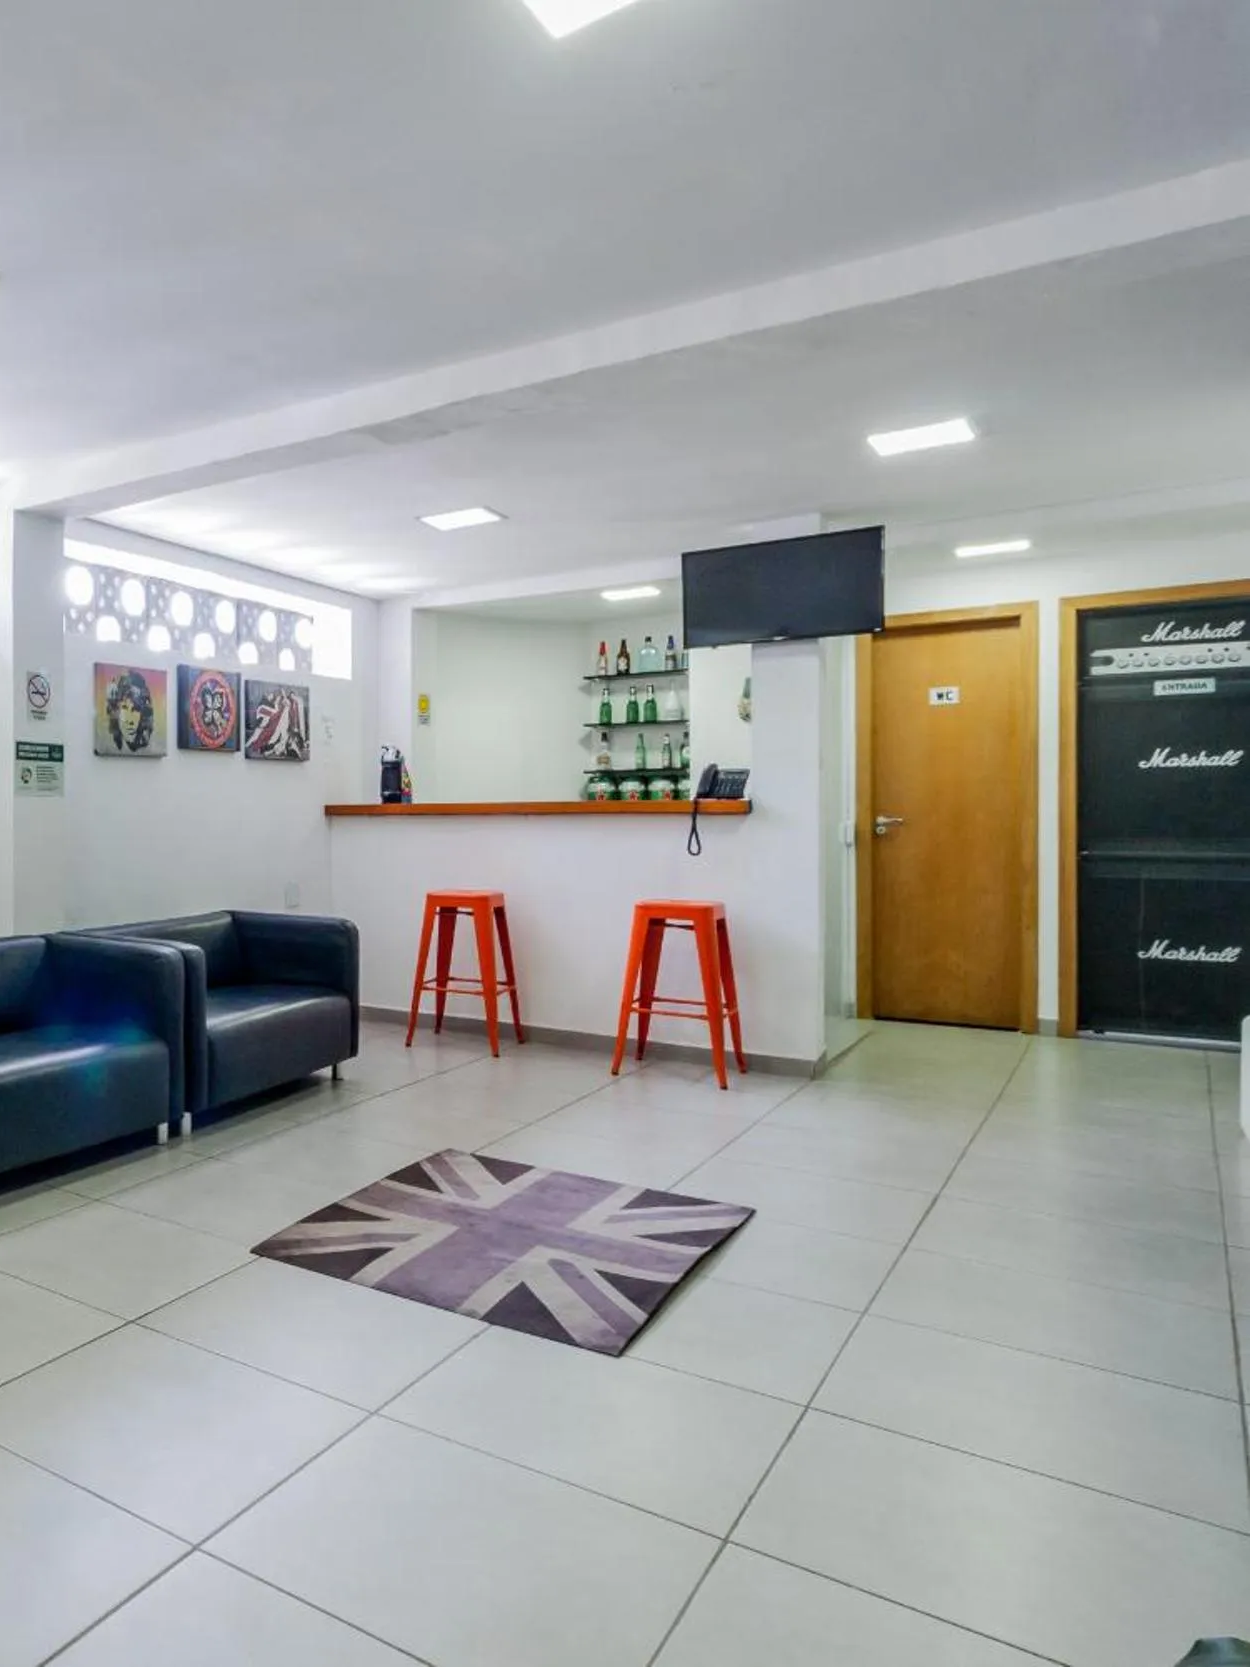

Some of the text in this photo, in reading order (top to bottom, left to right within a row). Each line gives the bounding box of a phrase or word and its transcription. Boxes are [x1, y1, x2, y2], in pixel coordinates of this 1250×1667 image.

[1141, 620, 1246, 642] Marshall
[1138, 747, 1244, 768] Marshall
[1137, 939, 1242, 962] Marshall
